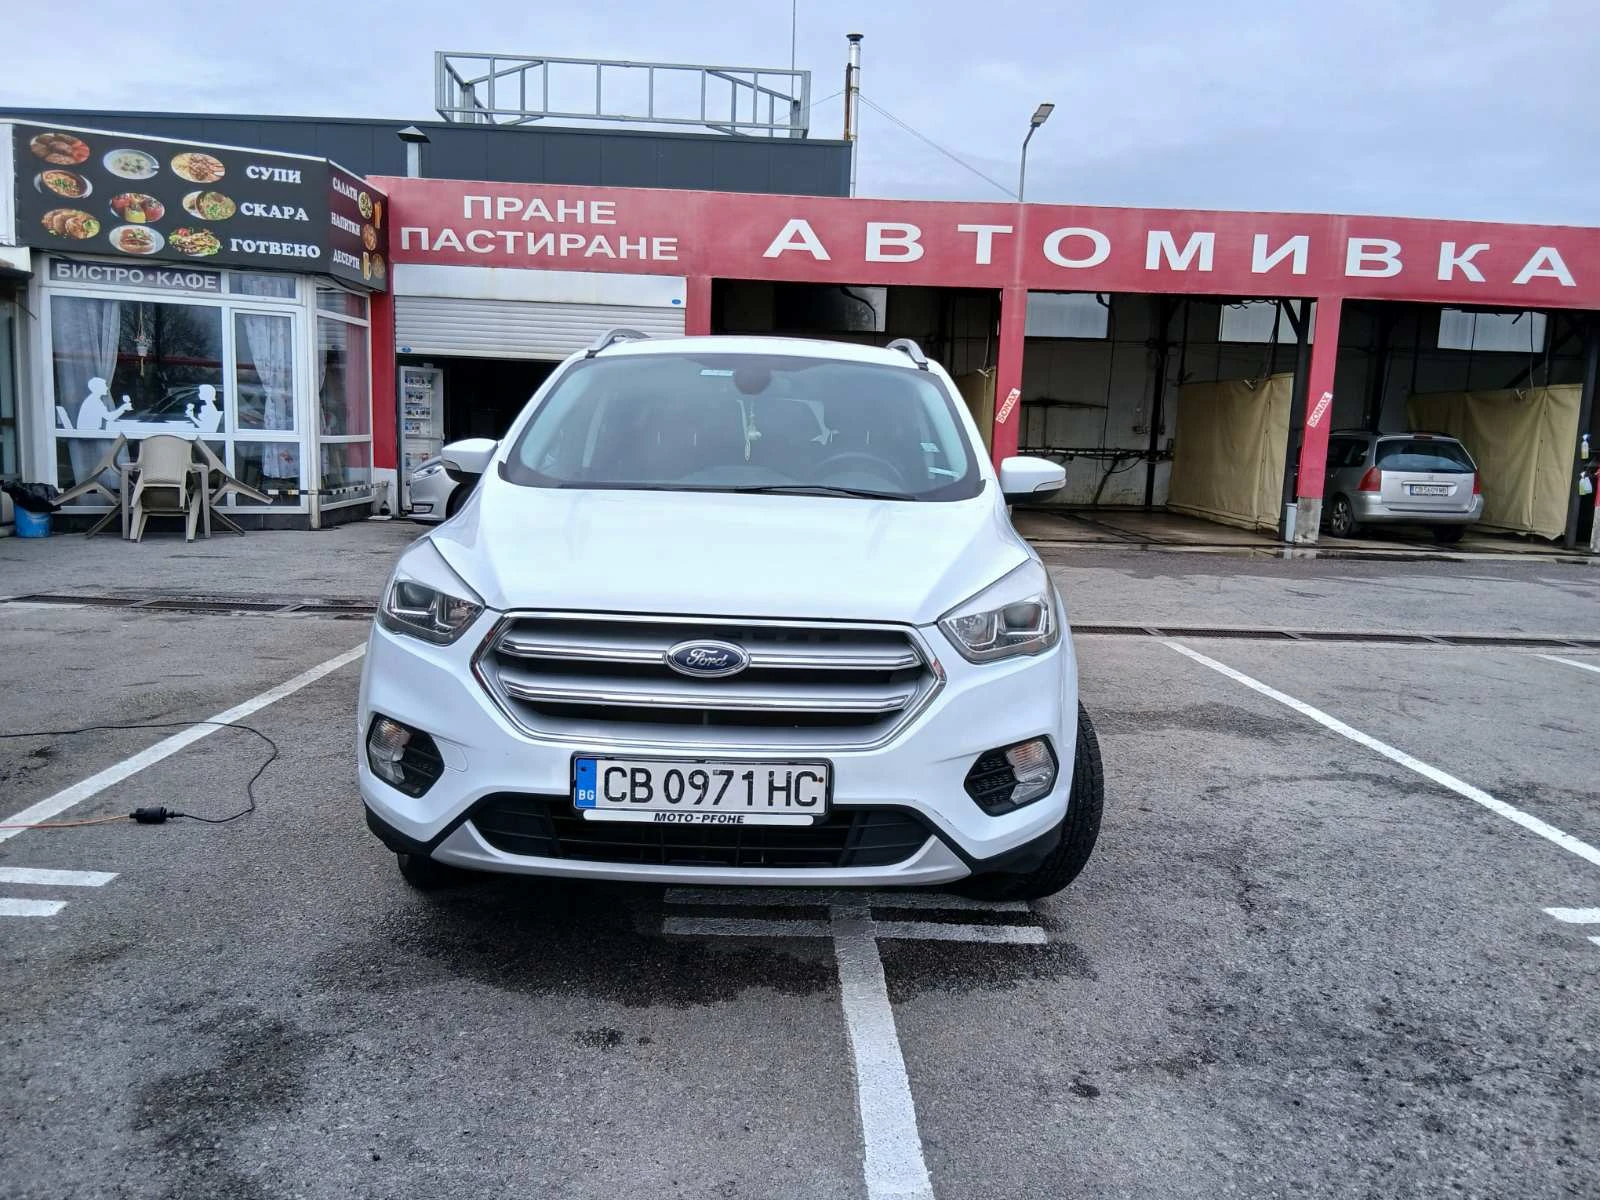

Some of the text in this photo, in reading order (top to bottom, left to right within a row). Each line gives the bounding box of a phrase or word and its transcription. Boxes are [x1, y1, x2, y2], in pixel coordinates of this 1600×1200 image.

[246, 165, 302, 184] СУПИ
[240, 202, 310, 221] СКАРА
[463, 195, 617, 225] ПРАНЕ
[230, 238, 321, 258] ГОТВЕНО
[401, 227, 679, 261] ПАСТИРАНЕ
[762, 218, 1577, 287] АВТОМИВКА
[998, 390, 1018, 423] SONAX
[686, 648, 729, 666] Ford
[578, 789, 595, 801] BG
[603, 766, 818, 807] CB 0971 HC
[653, 812, 745, 825] MOTO-PFOHE
